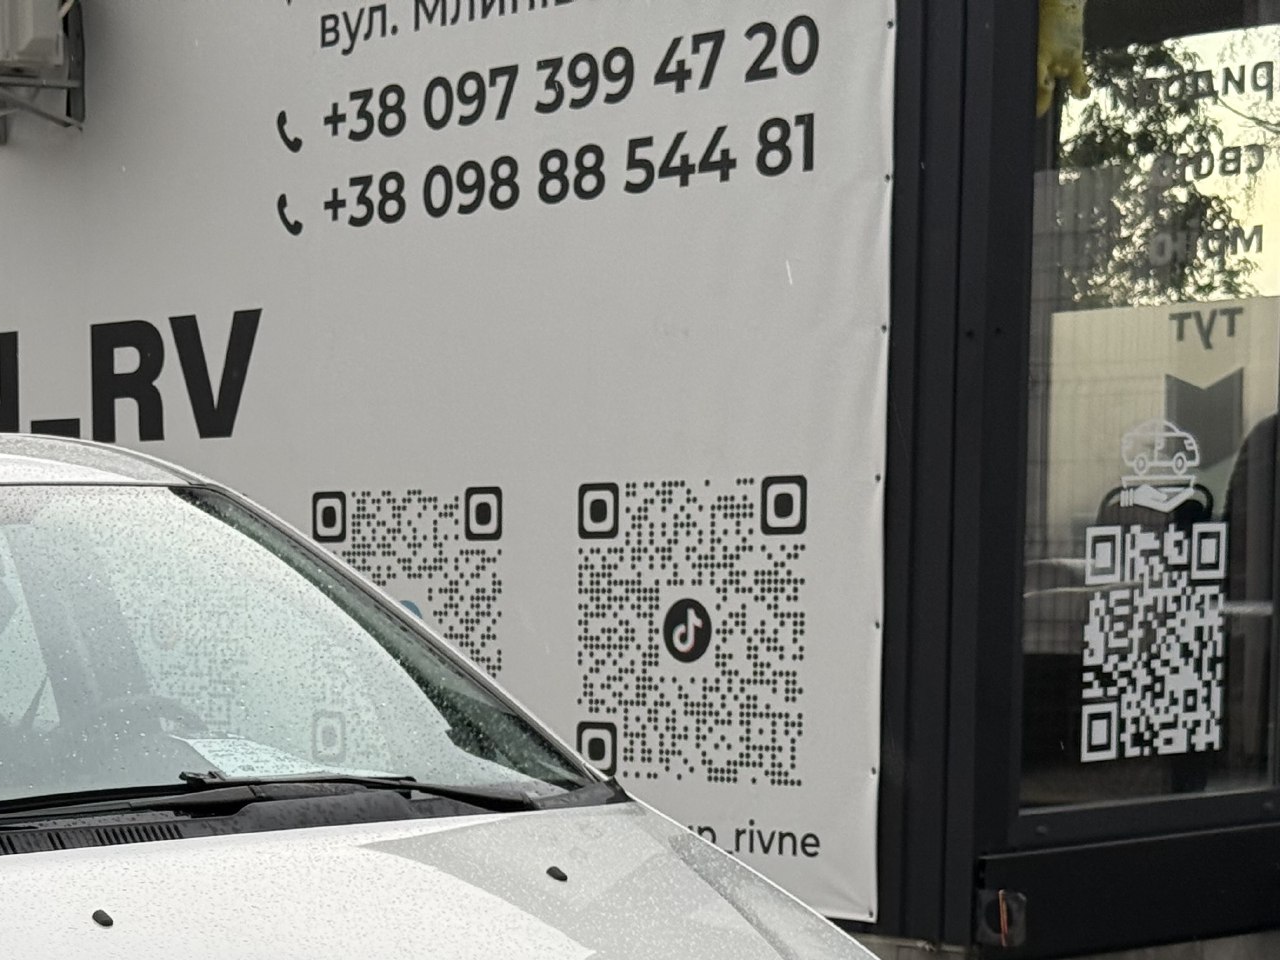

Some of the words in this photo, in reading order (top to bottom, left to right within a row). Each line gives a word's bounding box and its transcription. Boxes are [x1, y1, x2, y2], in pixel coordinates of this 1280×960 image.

[320, 3, 398, 56] вул.
[323, 84, 407, 142] +38
[423, 65, 519, 131] 097
[534, 47, 635, 114] 399
[653, 30, 726, 94] 47
[744, 15, 820, 83] 20
[323, 170, 407, 228] +38
[422, 155, 520, 219] 098
[538, 143, 606, 205] 88
[623, 125, 737, 194] 544
[756, 112, 815, 177] 81
